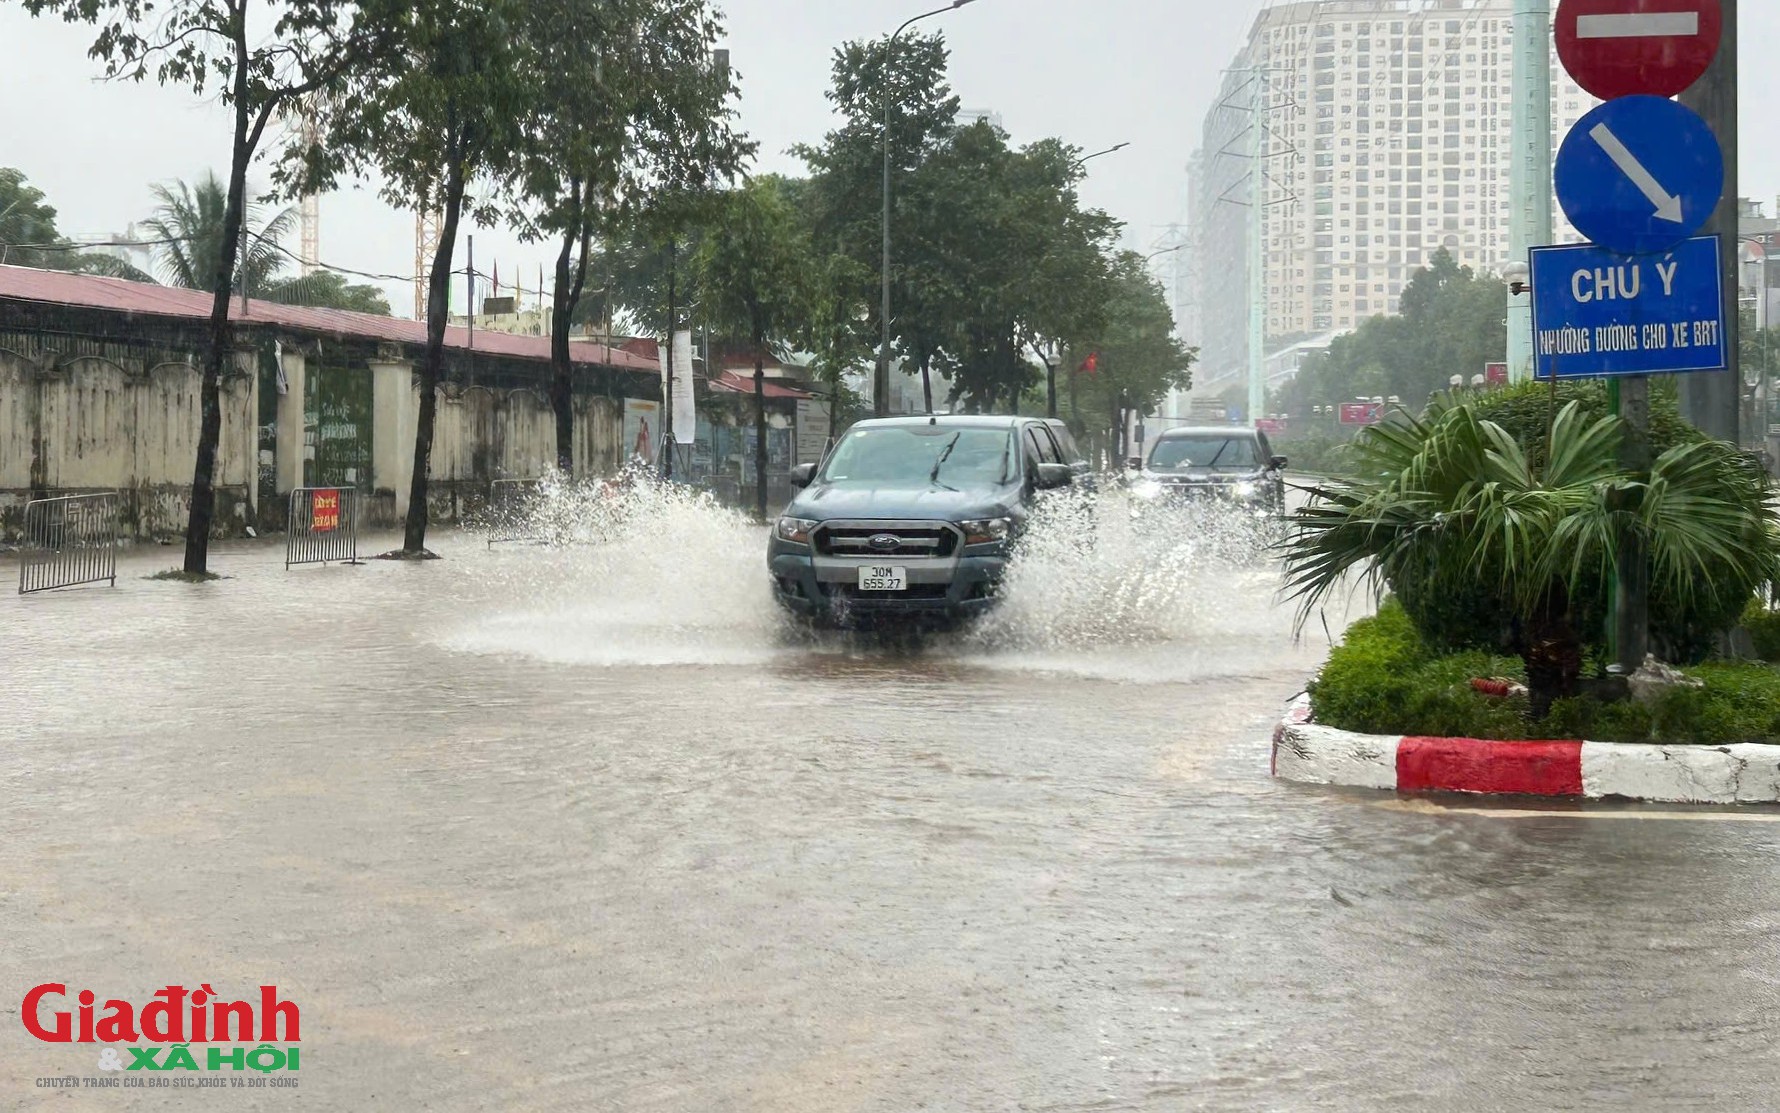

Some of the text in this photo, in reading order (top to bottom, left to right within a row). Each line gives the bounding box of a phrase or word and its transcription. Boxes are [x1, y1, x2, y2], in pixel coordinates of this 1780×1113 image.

[1571, 252, 1678, 303] CHÚ Ý
[1642, 323, 1666, 349] CHO
[1672, 321, 1688, 348] XE
[1693, 320, 1718, 346] BRT
[863, 578, 901, 589] 655.27
